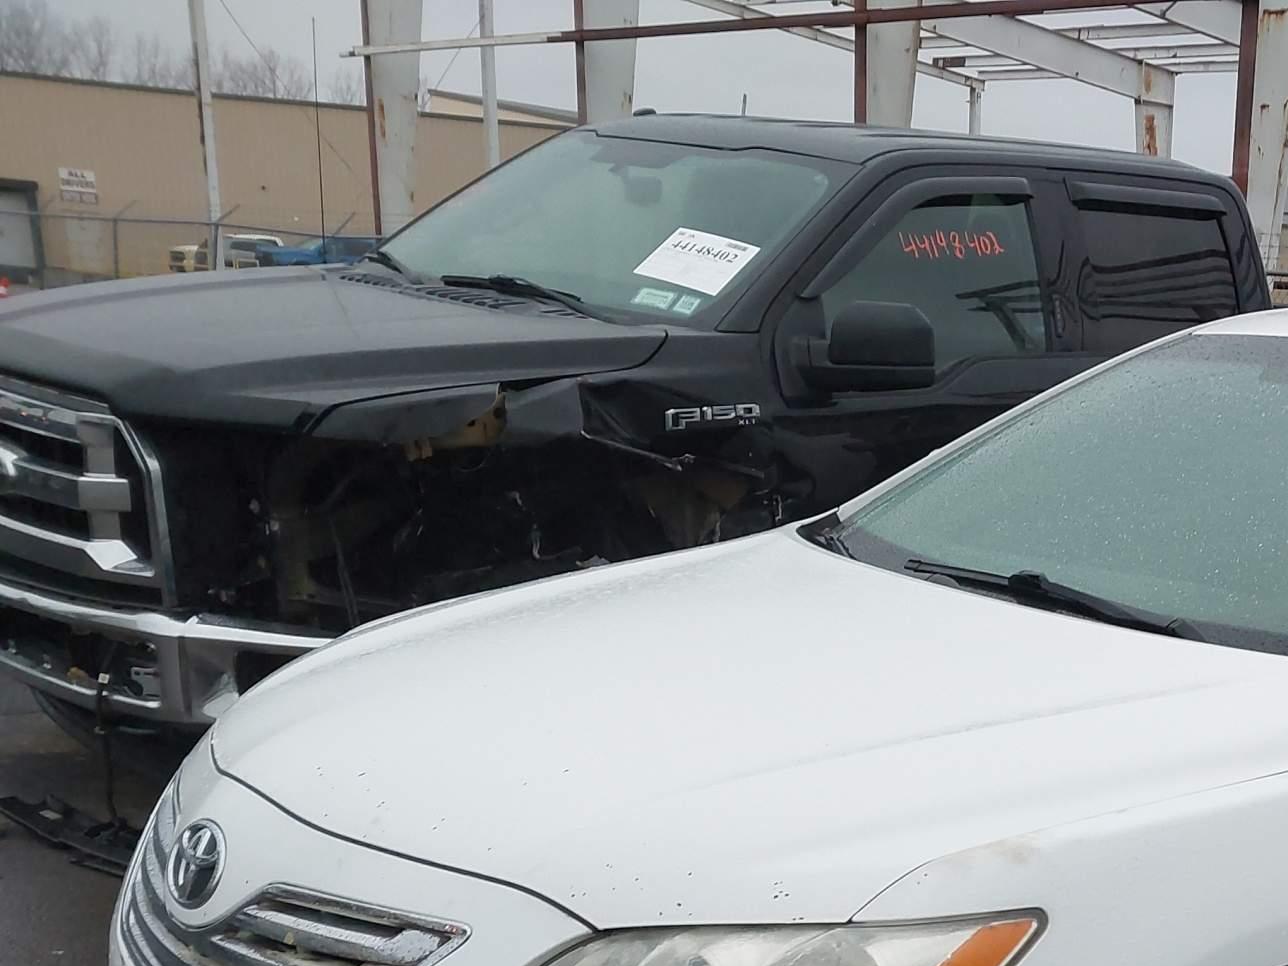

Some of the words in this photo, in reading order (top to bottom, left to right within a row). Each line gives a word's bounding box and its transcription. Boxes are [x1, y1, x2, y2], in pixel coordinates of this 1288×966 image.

[67, 170, 86, 178] ALL
[671, 240, 739, 263] 44148402
[898, 229, 1005, 259] 44148402
